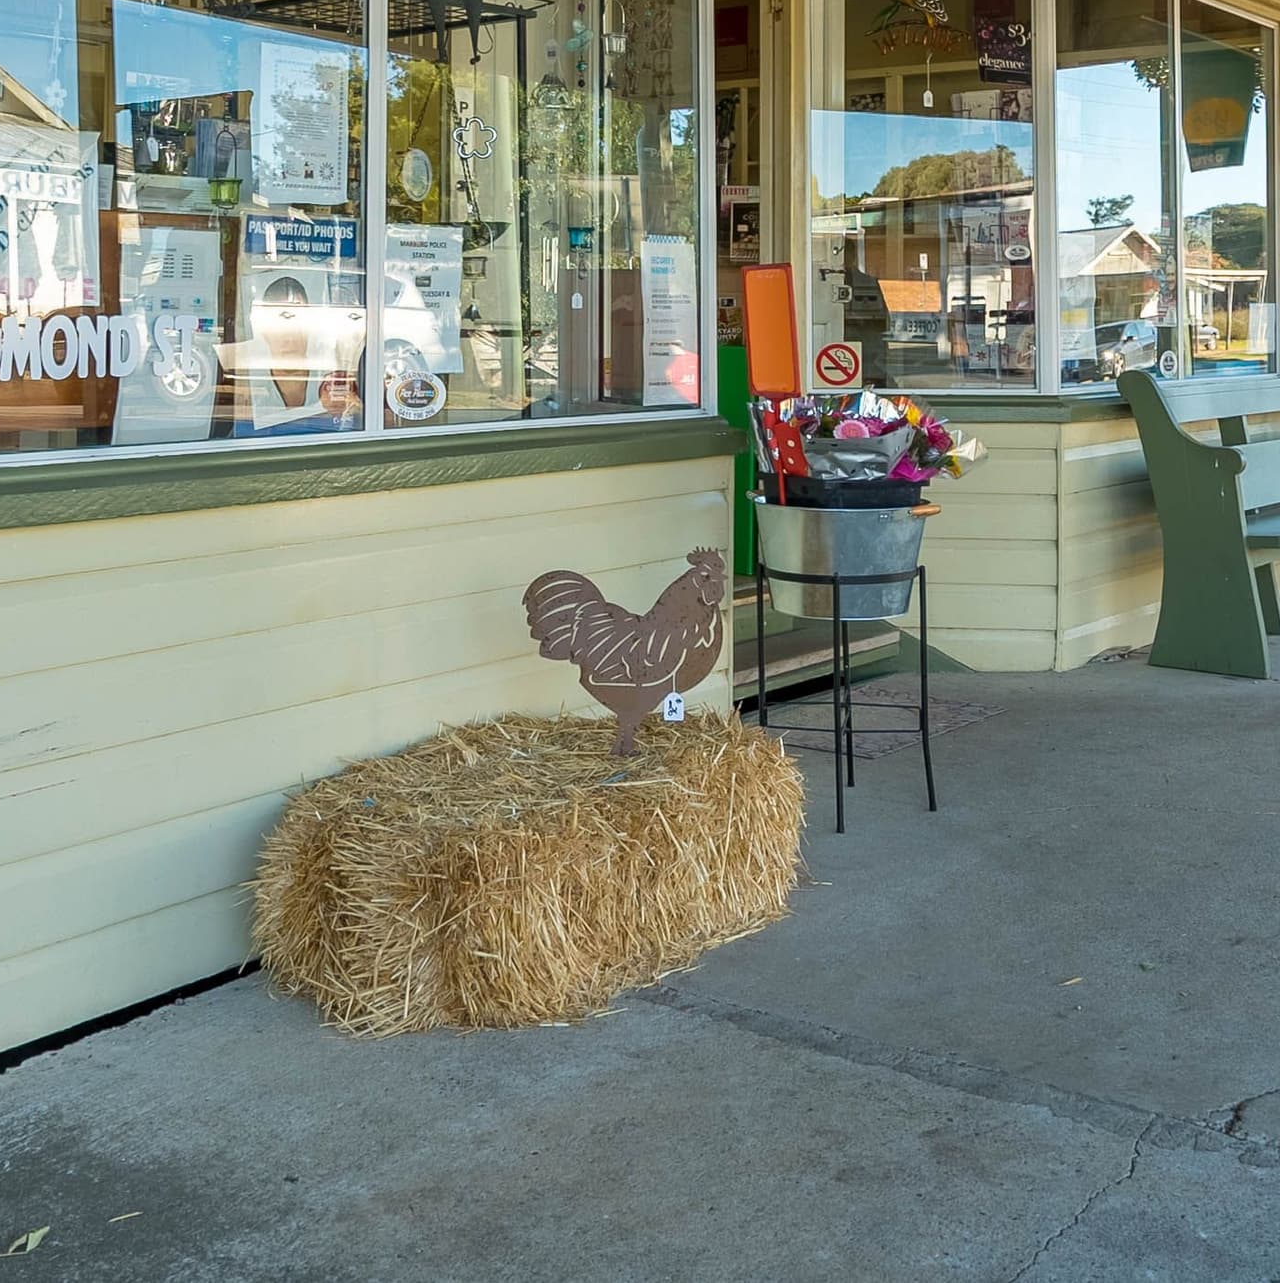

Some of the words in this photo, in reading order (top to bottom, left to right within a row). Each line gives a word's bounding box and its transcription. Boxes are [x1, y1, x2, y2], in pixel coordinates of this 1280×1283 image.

[978, 52, 1025, 70] elegance
[314, 225, 354, 239] PHOTOS
[295, 241, 311, 253] YOU
[311, 241, 332, 253] WAIT
[429, 241, 447, 249] POLICE
[412, 251, 435, 259] STATION
[152, 315, 200, 377] ST
